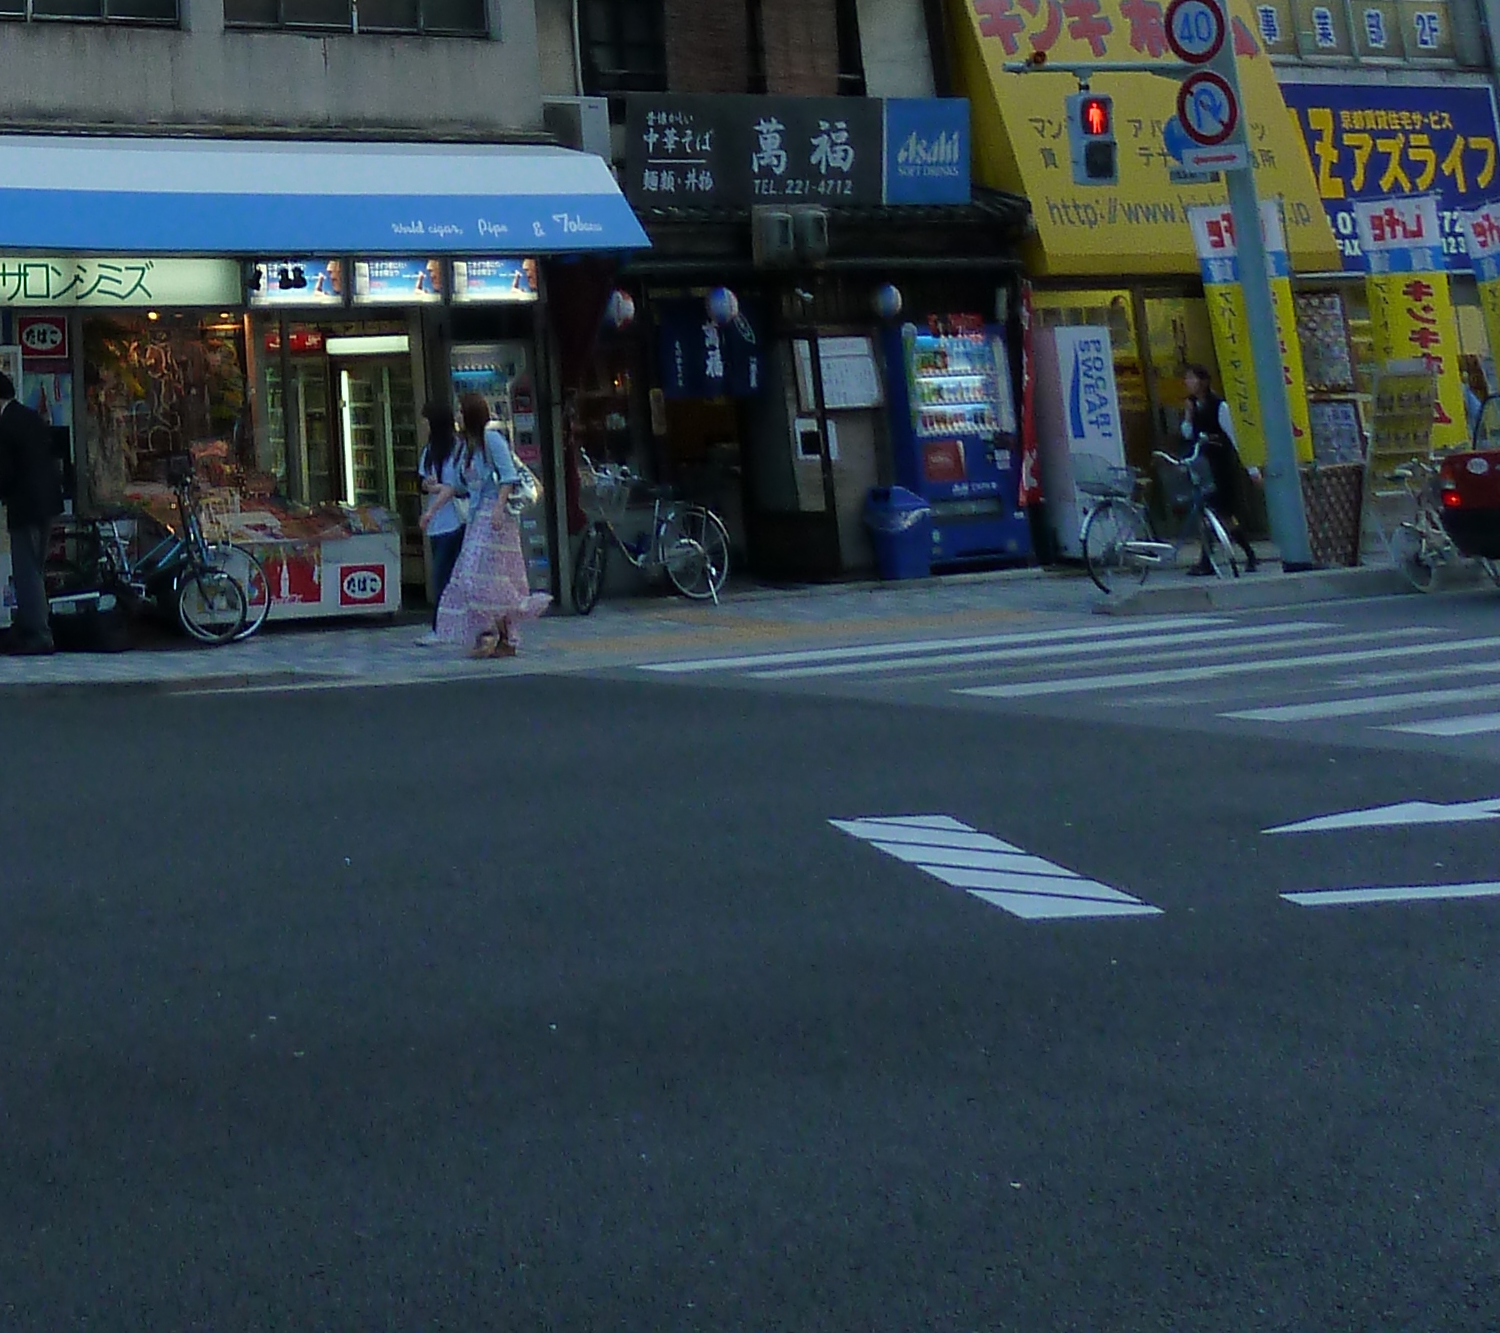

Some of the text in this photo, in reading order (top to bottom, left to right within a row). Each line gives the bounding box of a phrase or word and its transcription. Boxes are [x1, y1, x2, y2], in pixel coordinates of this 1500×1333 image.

[1178, 10, 1212, 44] 40
[1414, 12, 1440, 49] 2F
[642, 127, 714, 153] 中華そば
[751, 117, 856, 175] 萬福
[897, 131, 960, 164] Asahi
[1342, 132, 1496, 193] アズライフ
[532, 222, 546, 237] &
[1079, 339, 1101, 429] SWEAT
[1090, 339, 1113, 438] POCARI
